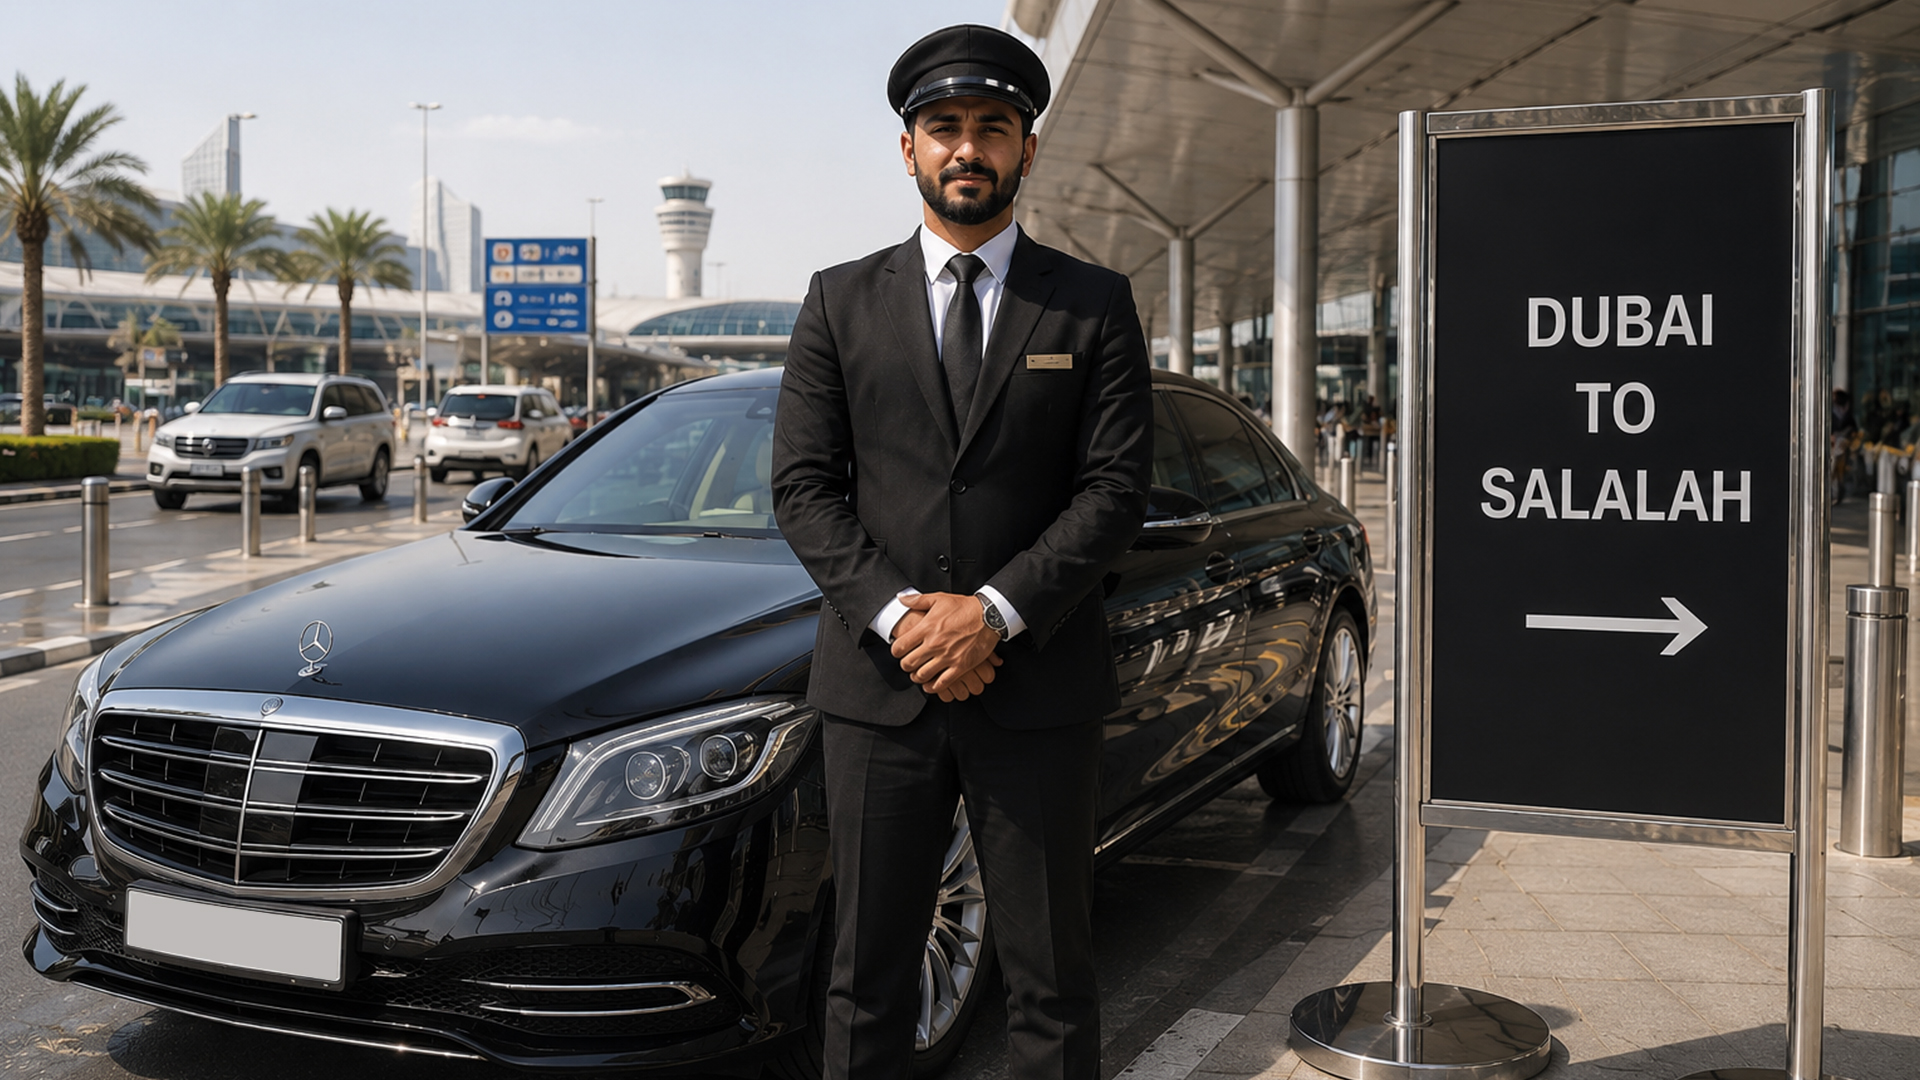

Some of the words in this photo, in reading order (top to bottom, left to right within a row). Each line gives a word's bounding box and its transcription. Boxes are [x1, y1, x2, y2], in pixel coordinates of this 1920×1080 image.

[1527, 293, 1713, 348] DUBAI
[1575, 381, 1656, 435] TO
[1480, 466, 1752, 523] SALALAH
